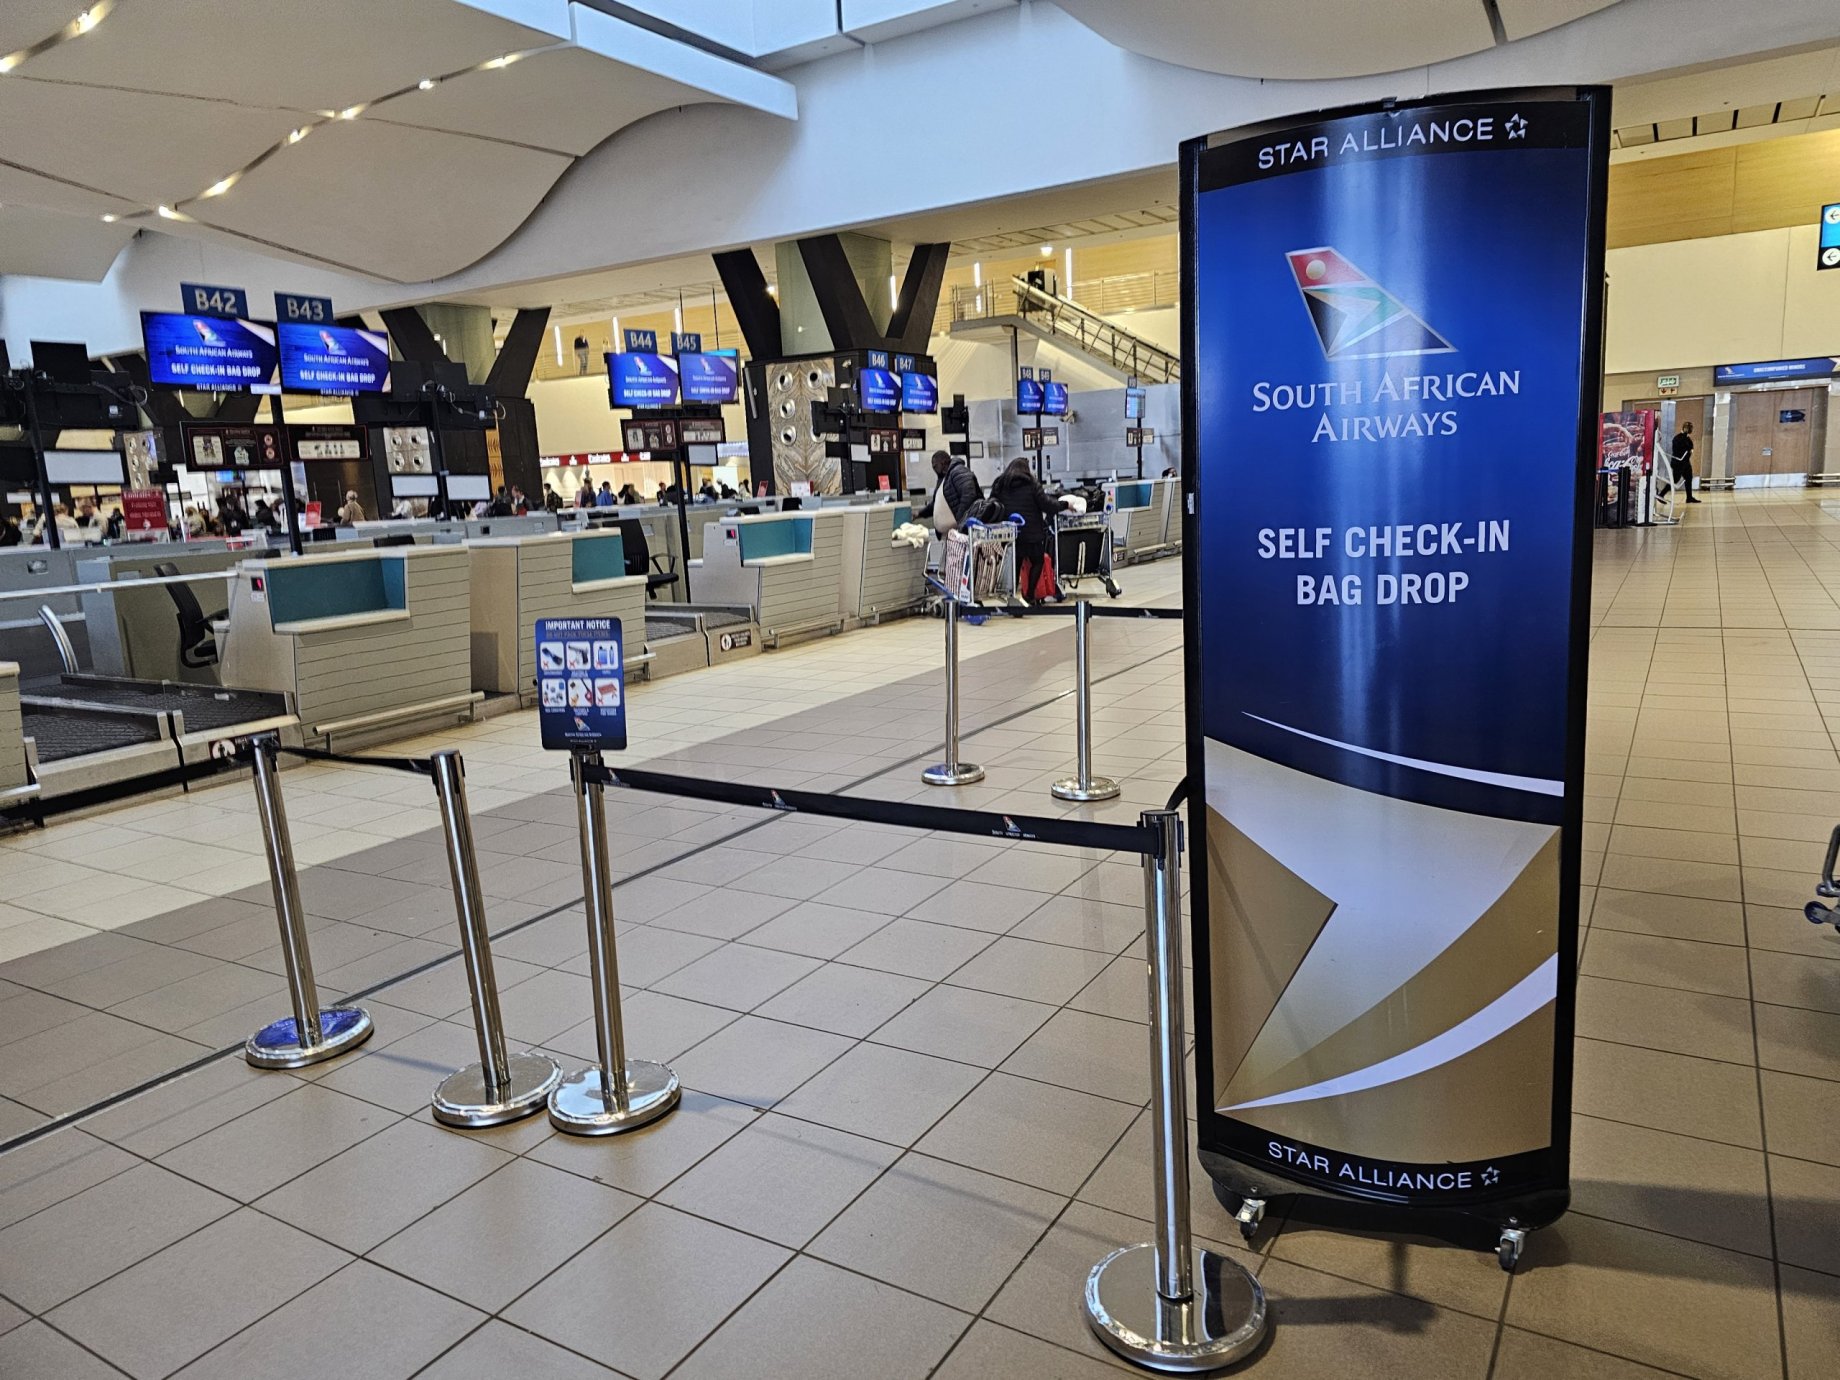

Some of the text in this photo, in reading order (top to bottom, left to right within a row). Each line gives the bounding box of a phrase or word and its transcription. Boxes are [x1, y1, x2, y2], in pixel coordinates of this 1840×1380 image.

[1258, 117, 1494, 169] STAR ALLIANCE
[194, 287, 238, 314] B42
[286, 298, 324, 321] B43
[630, 331, 653, 349] B44
[676, 334, 697, 351] B45
[171, 362, 261, 378] SELF CHECK-IN BAG DROP
[1252, 370, 1520, 412] SOUTH AFRICAN
[1311, 411, 1458, 443] AIRWAYS
[1257, 519, 1510, 559] SELF CHECK-IN
[1297, 571, 1469, 605] BAG DROP
[545, 619, 611, 631] IMPORTANT NOTICE
[1268, 1141, 1472, 1190] STAR ALLIANCE
